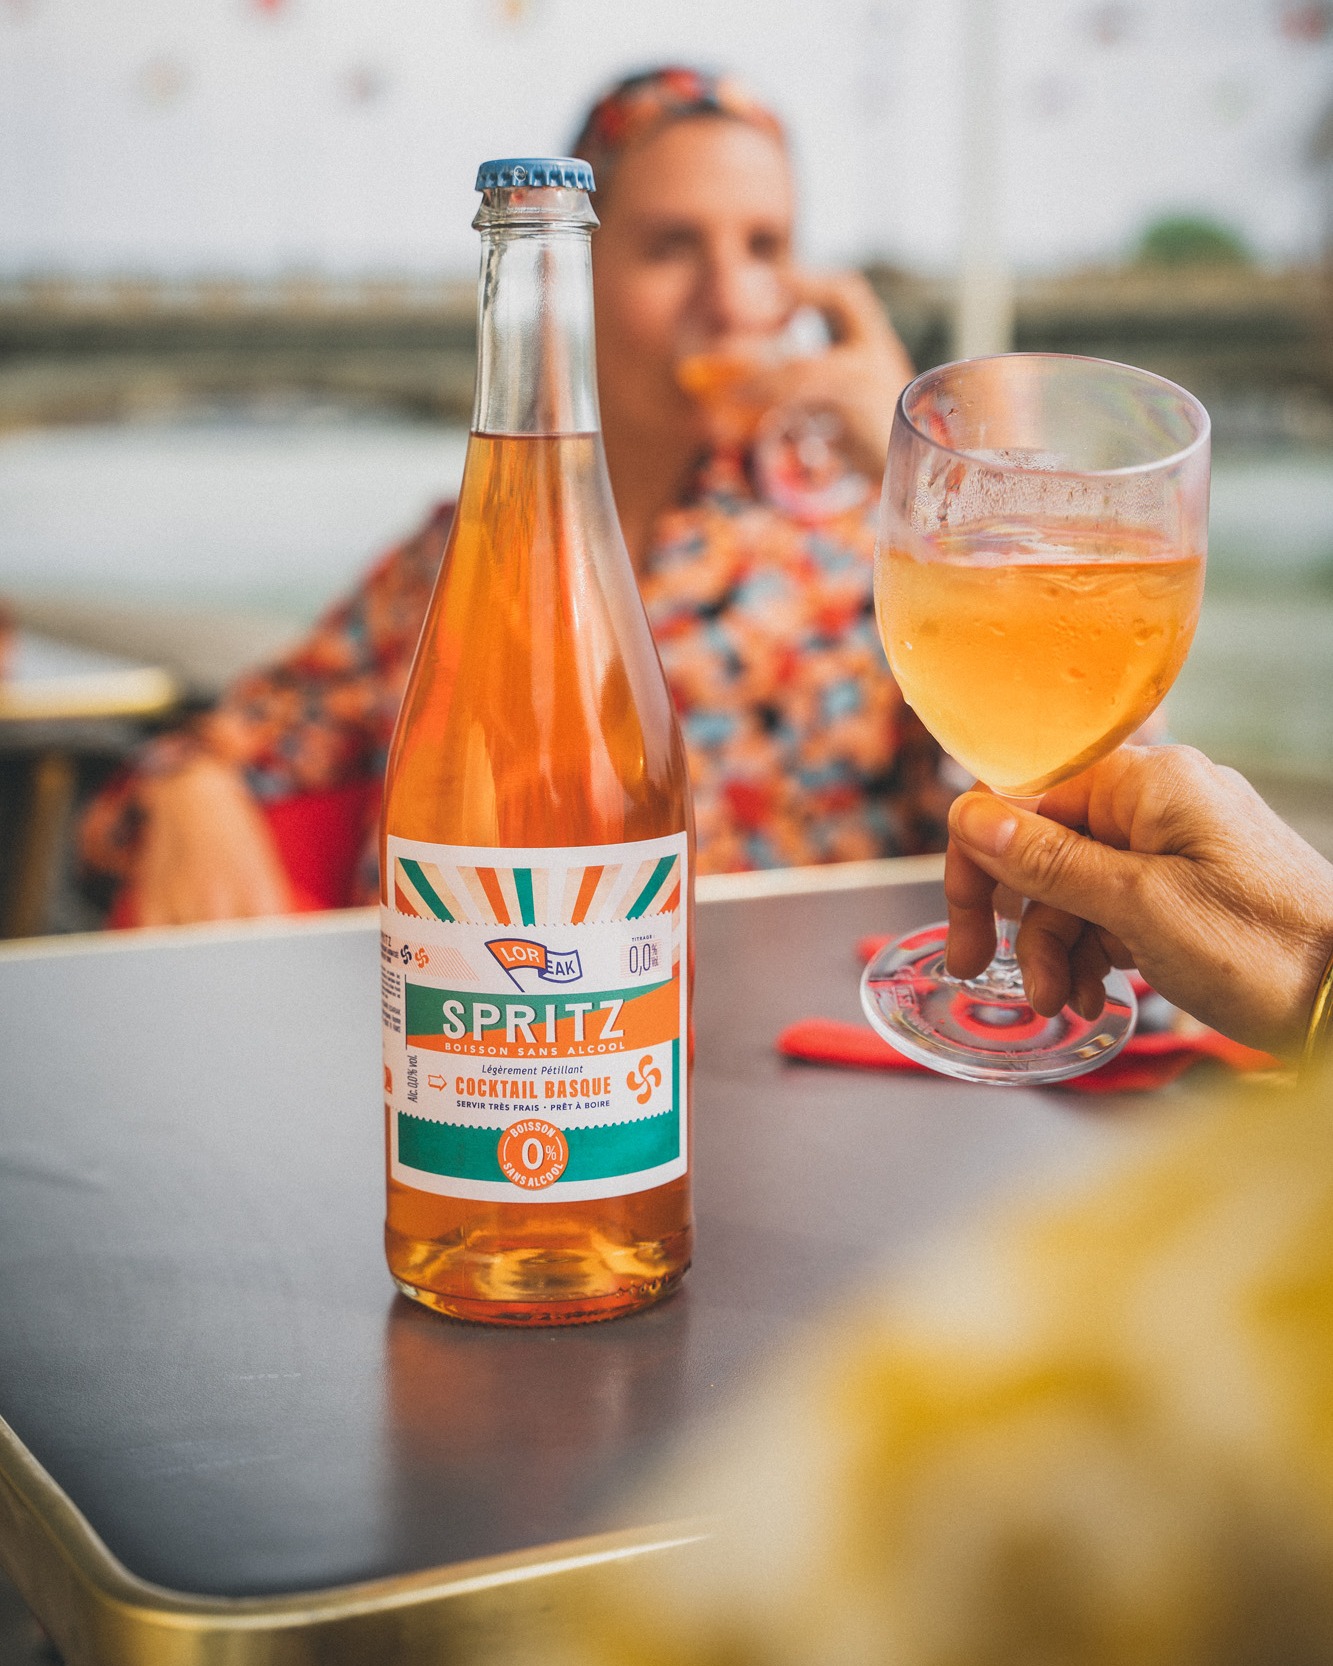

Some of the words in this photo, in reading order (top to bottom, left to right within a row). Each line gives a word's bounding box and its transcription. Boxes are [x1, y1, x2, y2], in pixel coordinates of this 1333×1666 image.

[442, 999, 625, 1044] SPRITZ
[444, 1042, 509, 1056] BOISSON
[517, 1047, 558, 1056] SANS
[567, 1041, 625, 1055] ALCOOL
[481, 1064, 538, 1076] Légèrement
[541, 1064, 584, 1075] Pétillant
[455, 1076, 538, 1099] COCKTAIL
[544, 1076, 612, 1099] BASQUE
[456, 1100, 486, 1110] SERVIR
[488, 1101, 510, 1111] TRÈS
[513, 1103, 540, 1112] FRAIS
[550, 1101, 573, 1111] PRÊT
[575, 1099, 582, 1110] À
[584, 1099, 611, 1109] BOIRE
[509, 1121, 556, 1138] BOISSON
[503, 1162, 527, 1185] SANS
[527, 1163, 564, 1187] ALCOOL
